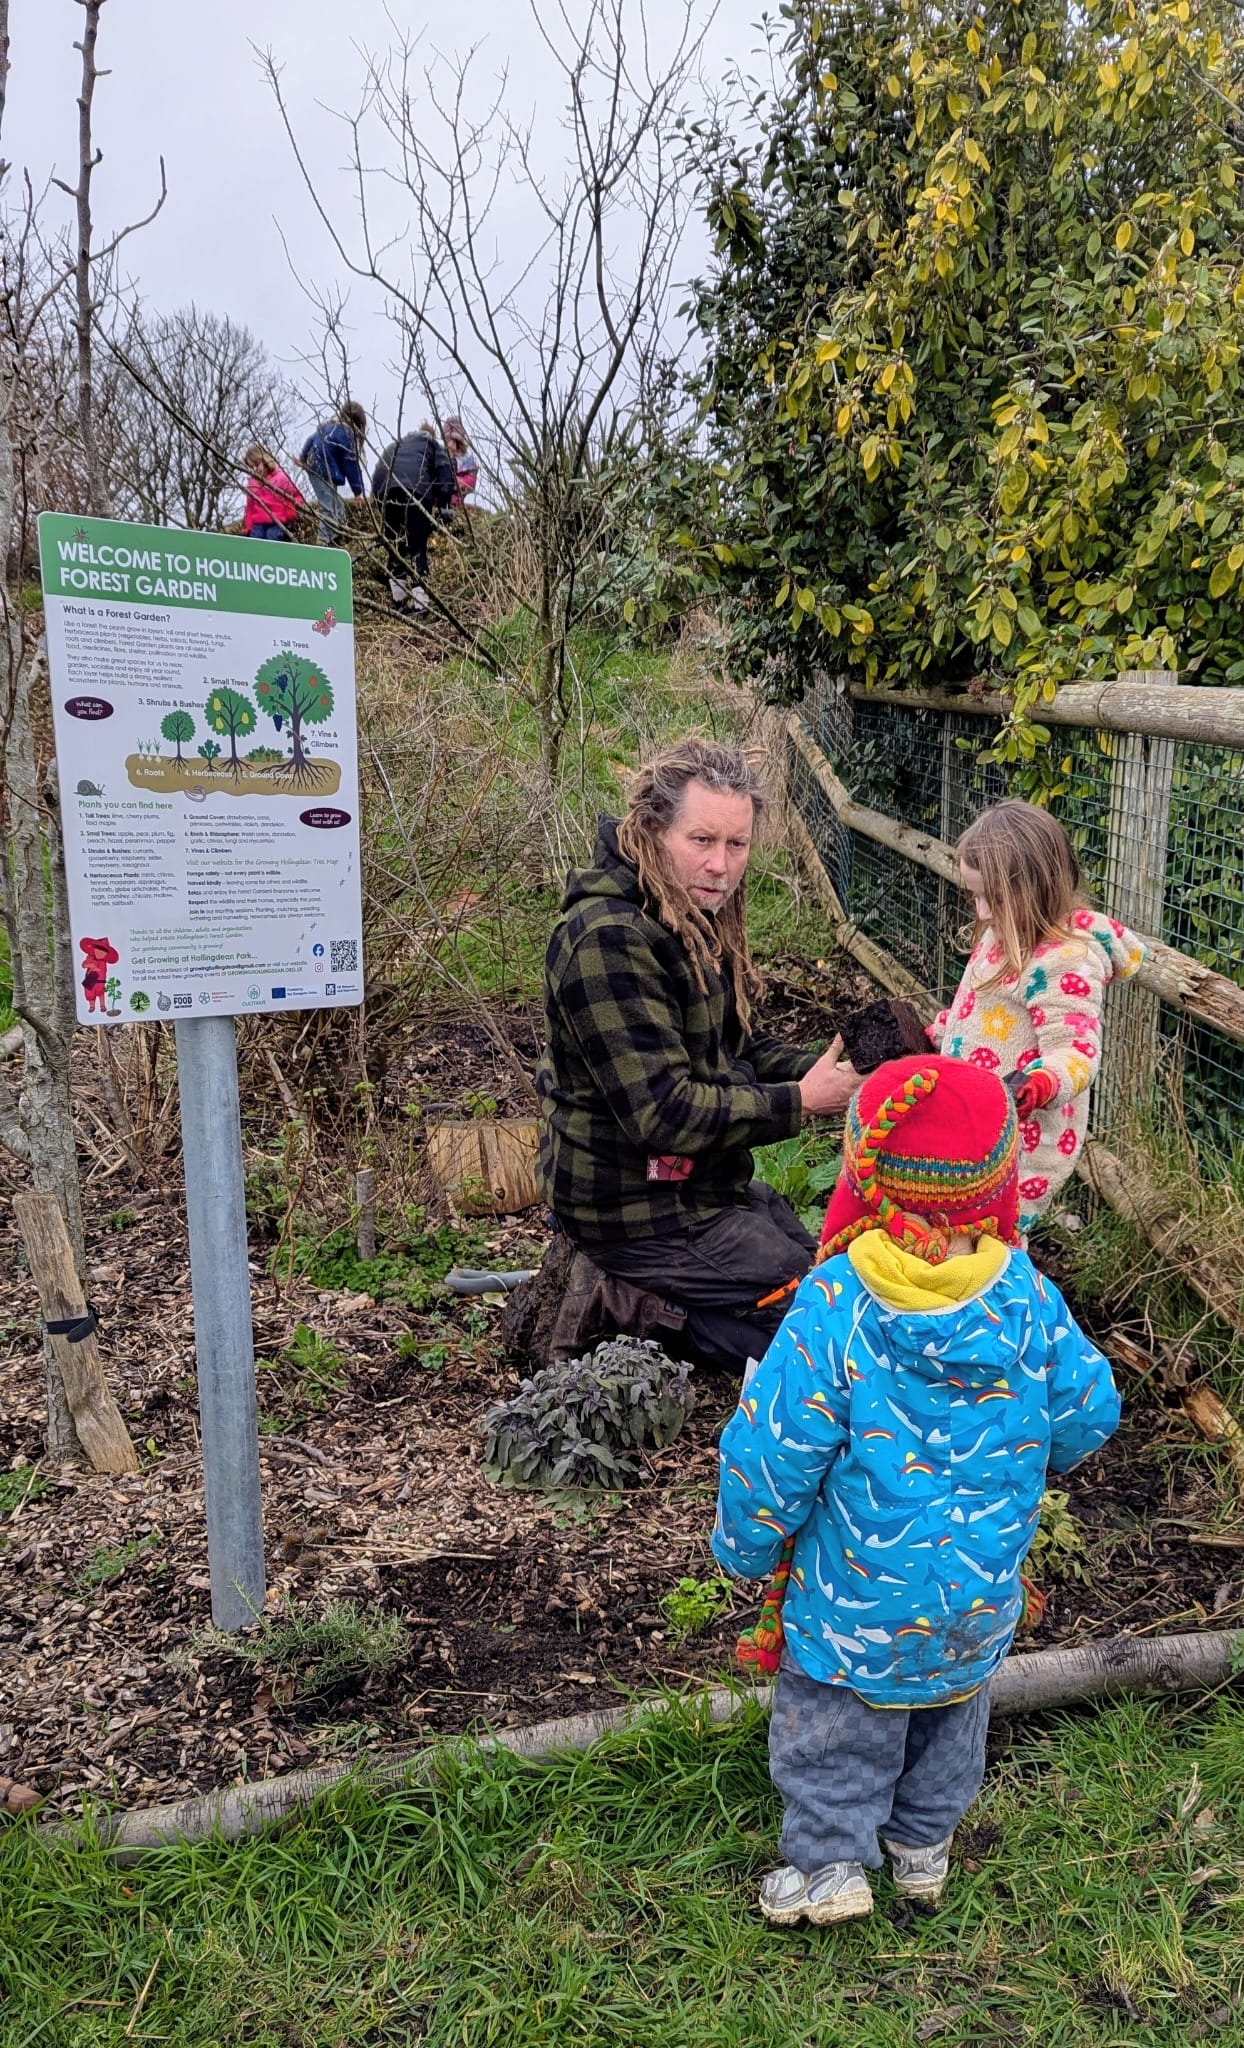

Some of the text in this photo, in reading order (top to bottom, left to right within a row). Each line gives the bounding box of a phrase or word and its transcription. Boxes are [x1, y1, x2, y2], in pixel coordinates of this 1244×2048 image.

[57, 540, 337, 591] WELCOME TO HOLLINGDEAN'S
[60, 567, 217, 602] FOREST GARDEN
[63, 604, 86, 615] What
[88, 606, 95, 616] is
[106, 609, 131, 619] Forest
[133, 611, 171, 622] Garden?
[280, 640, 291, 648] Tall
[292, 641, 309, 649] Trees
[210, 678, 230, 686] Small
[146, 698, 171, 706] Shrubs
[180, 700, 204, 708] Bushes
[318, 730, 332, 738] Vine
[310, 740, 338, 748] Climbers
[192, 770, 232, 778] Herbaceous
[250, 771, 274, 779] Ground
[275, 772, 294, 780] Cover
[78, 800, 102, 808] Plants
[104, 802, 119, 810] you
[156, 802, 173, 810] here
[148, 956, 180, 964] Growing
[190, 954, 234, 962] Hollingdean
[174, 996, 192, 1004] FOOD
